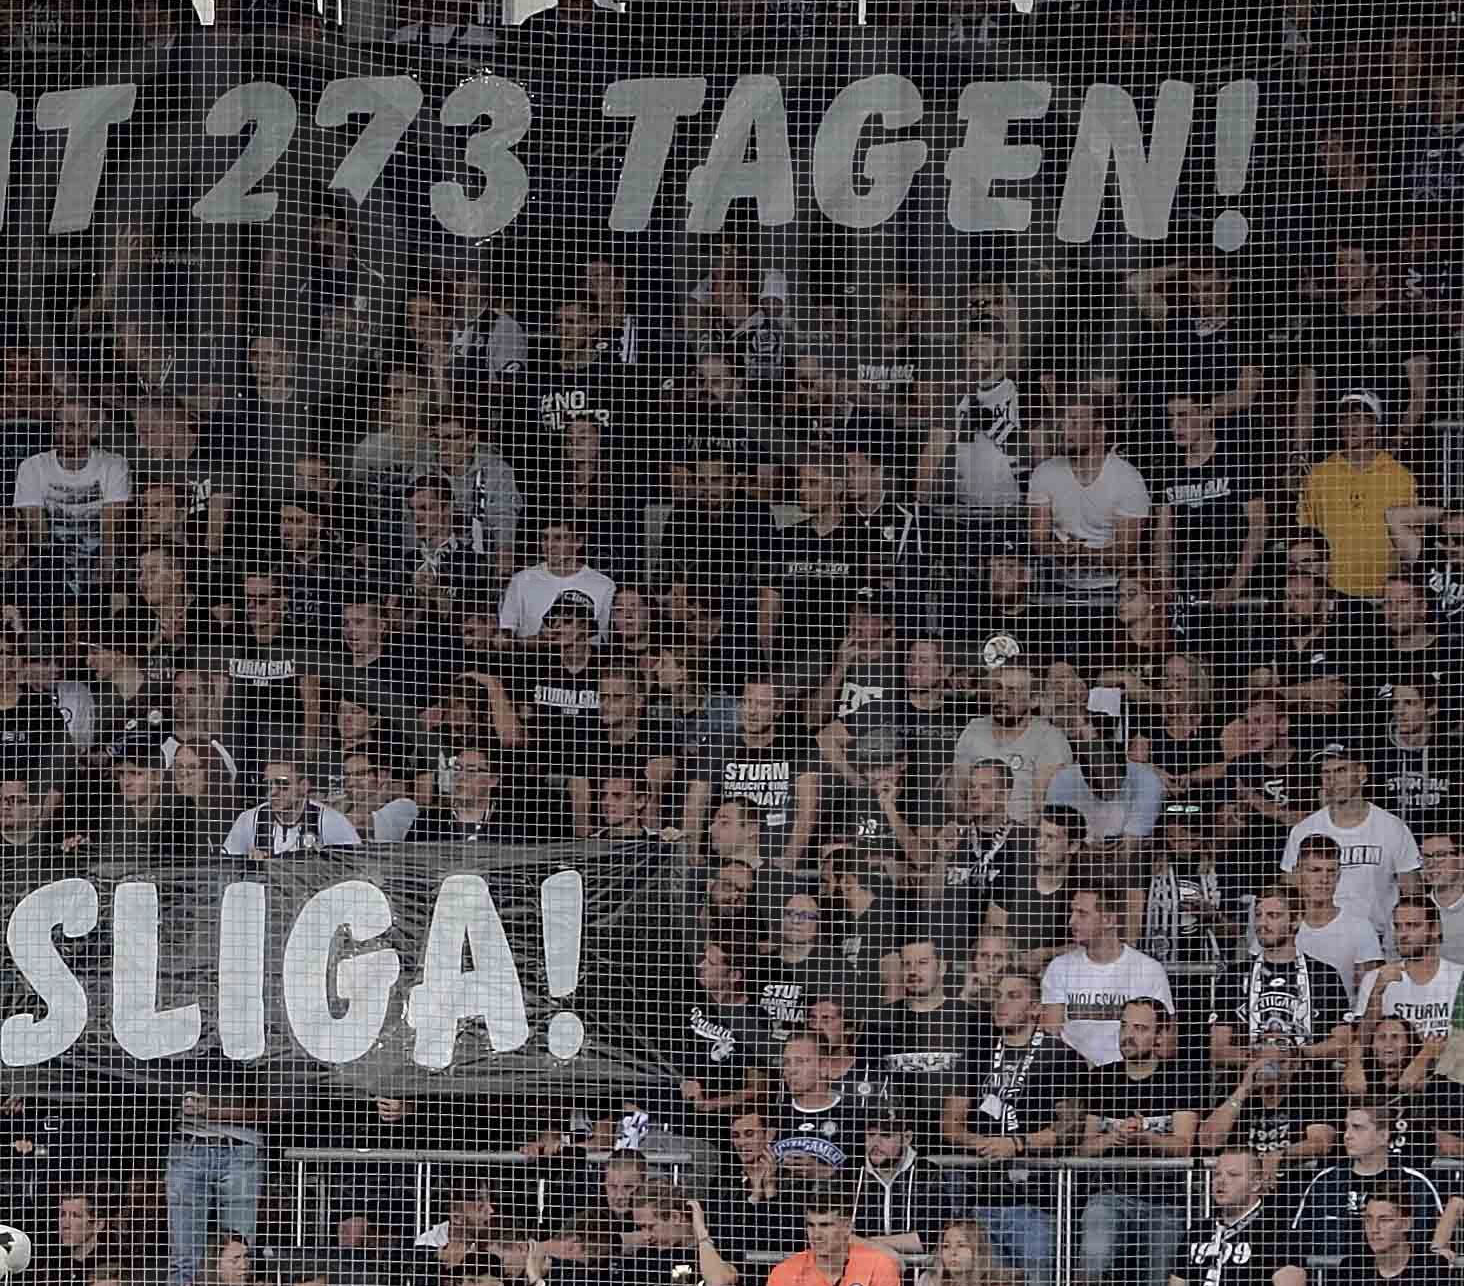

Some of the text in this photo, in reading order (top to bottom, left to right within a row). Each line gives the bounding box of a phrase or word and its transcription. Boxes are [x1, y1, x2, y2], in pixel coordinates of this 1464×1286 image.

[193, 72, 534, 240] 273
[603, 72, 1261, 254] TAGEN!
[724, 762, 790, 782] STURM
[1394, 1003, 1450, 1020] STURM
